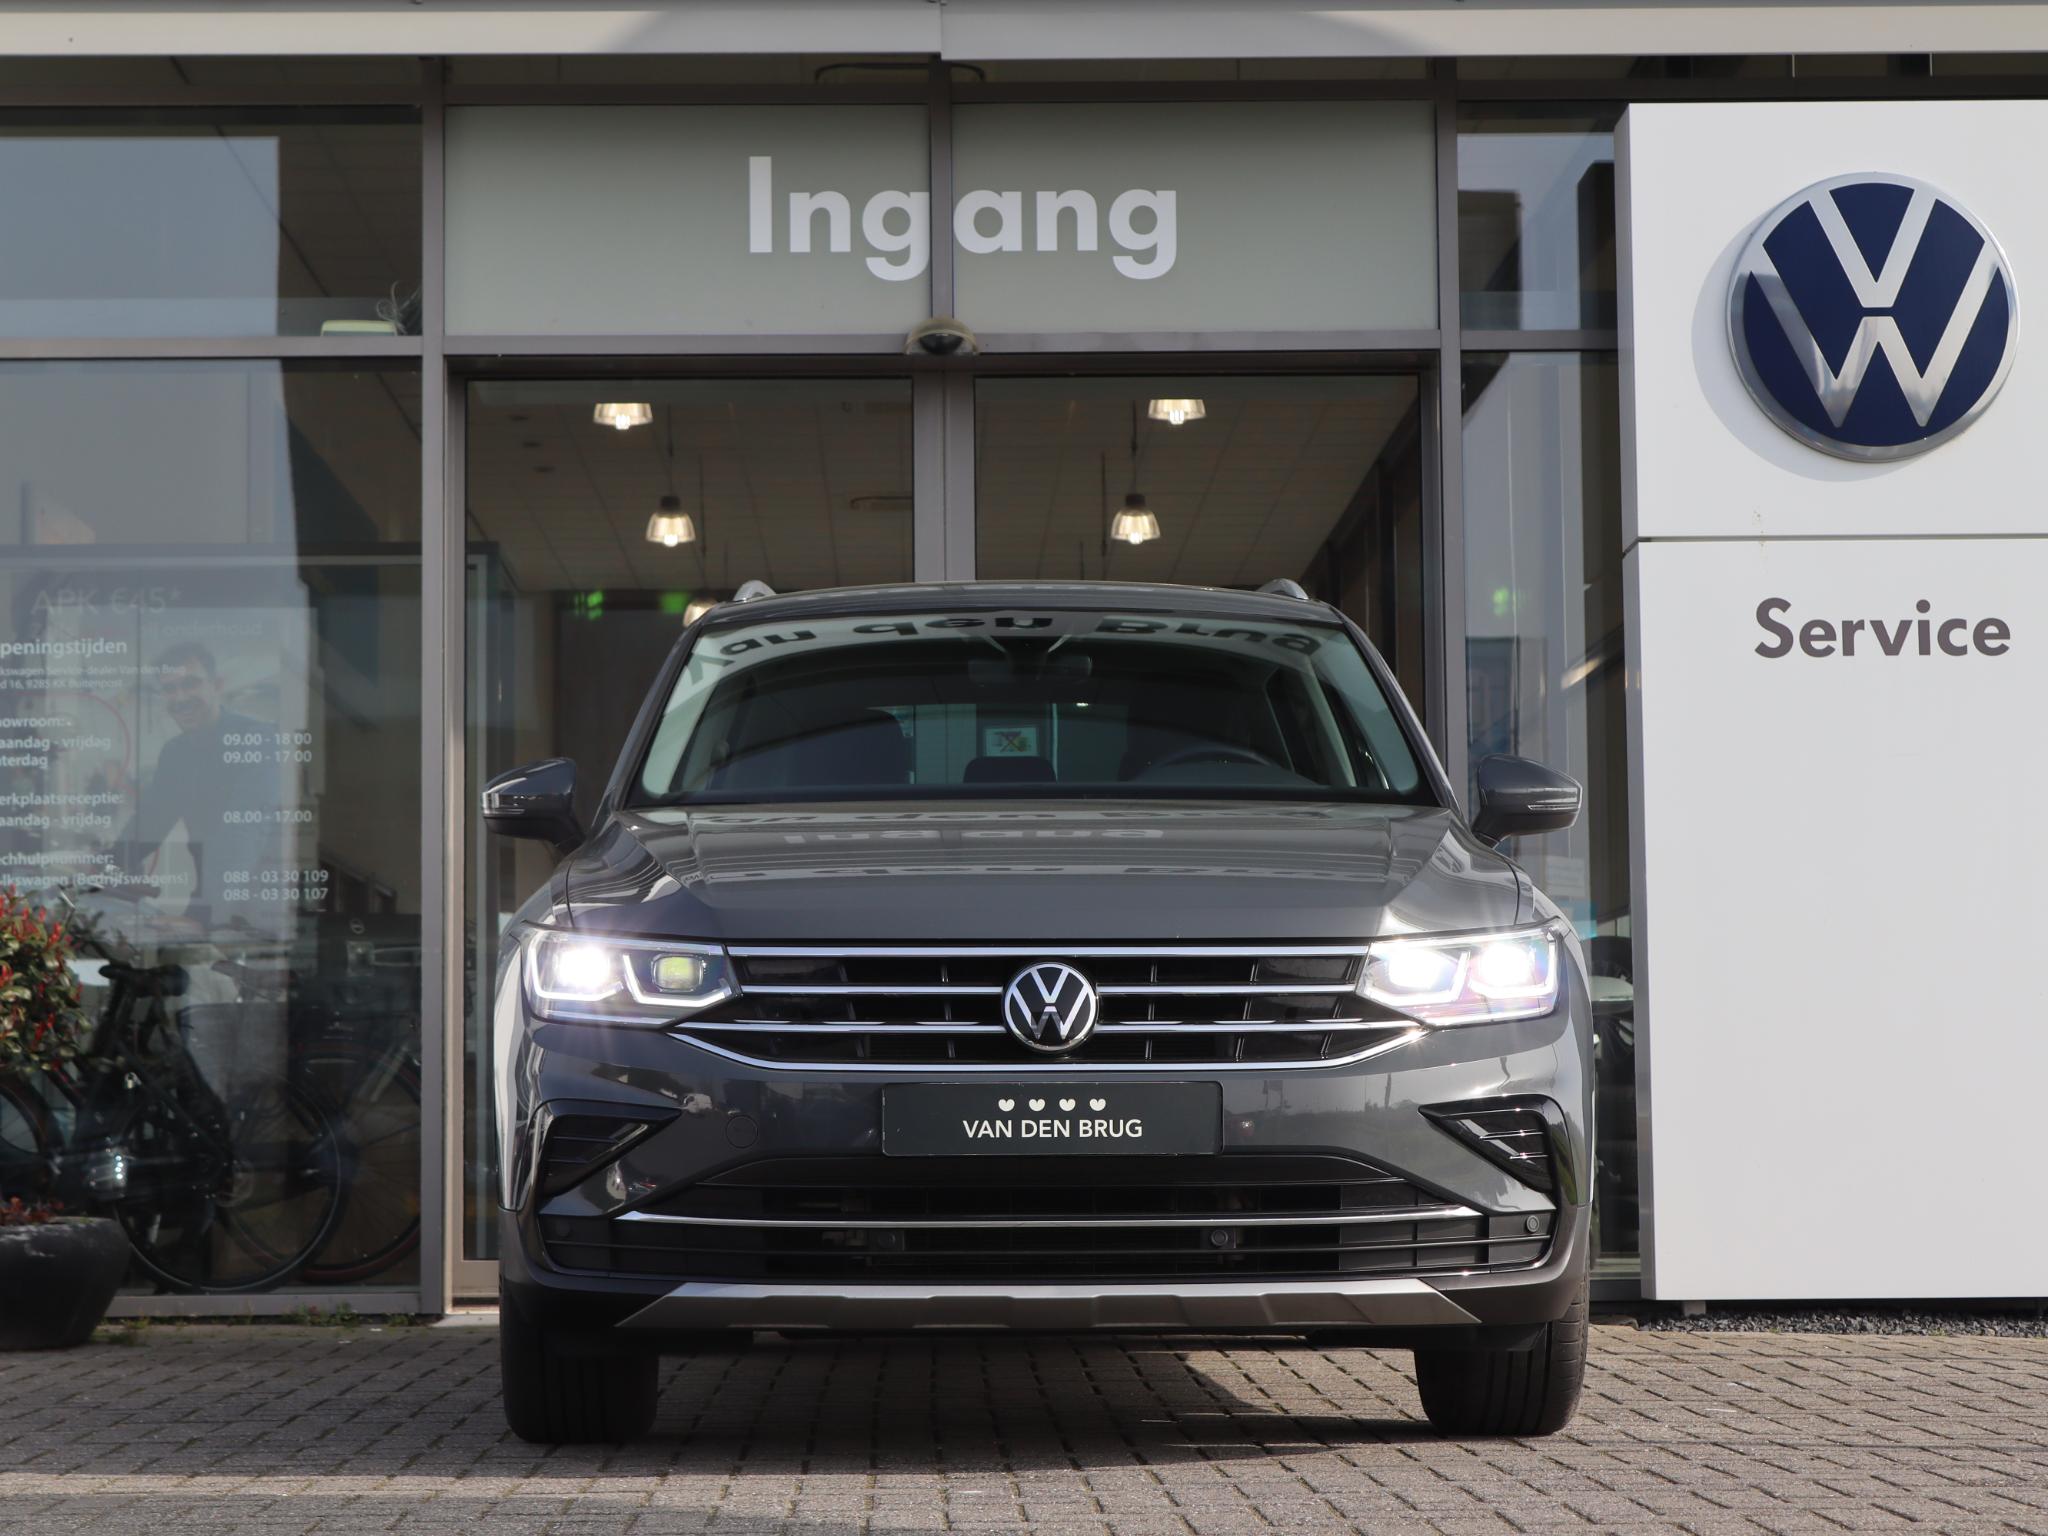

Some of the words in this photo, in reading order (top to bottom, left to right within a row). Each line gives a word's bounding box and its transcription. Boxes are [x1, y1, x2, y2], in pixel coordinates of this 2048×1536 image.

[749, 156, 1177, 281] Ingang
[31, 588, 100, 615] APK
[1754, 597, 2011, 659] Service
[61, 736, 111, 752] vrijdag
[223, 733, 262, 746] 09.00
[223, 750, 262, 764] 09.00
[61, 812, 111, 830] vrijdag
[223, 810, 262, 824] 08.00
[223, 871, 250, 884] 088
[261, 870, 279, 883] 03
[303, 869, 329, 882] 109
[223, 888, 250, 901] 088
[261, 888, 279, 901] 03
[303, 887, 329, 900] 107
[963, 1119, 1013, 1139] VAN
[1021, 1119, 1070, 1139] DEN
[1078, 1119, 1143, 1139] BRUG
